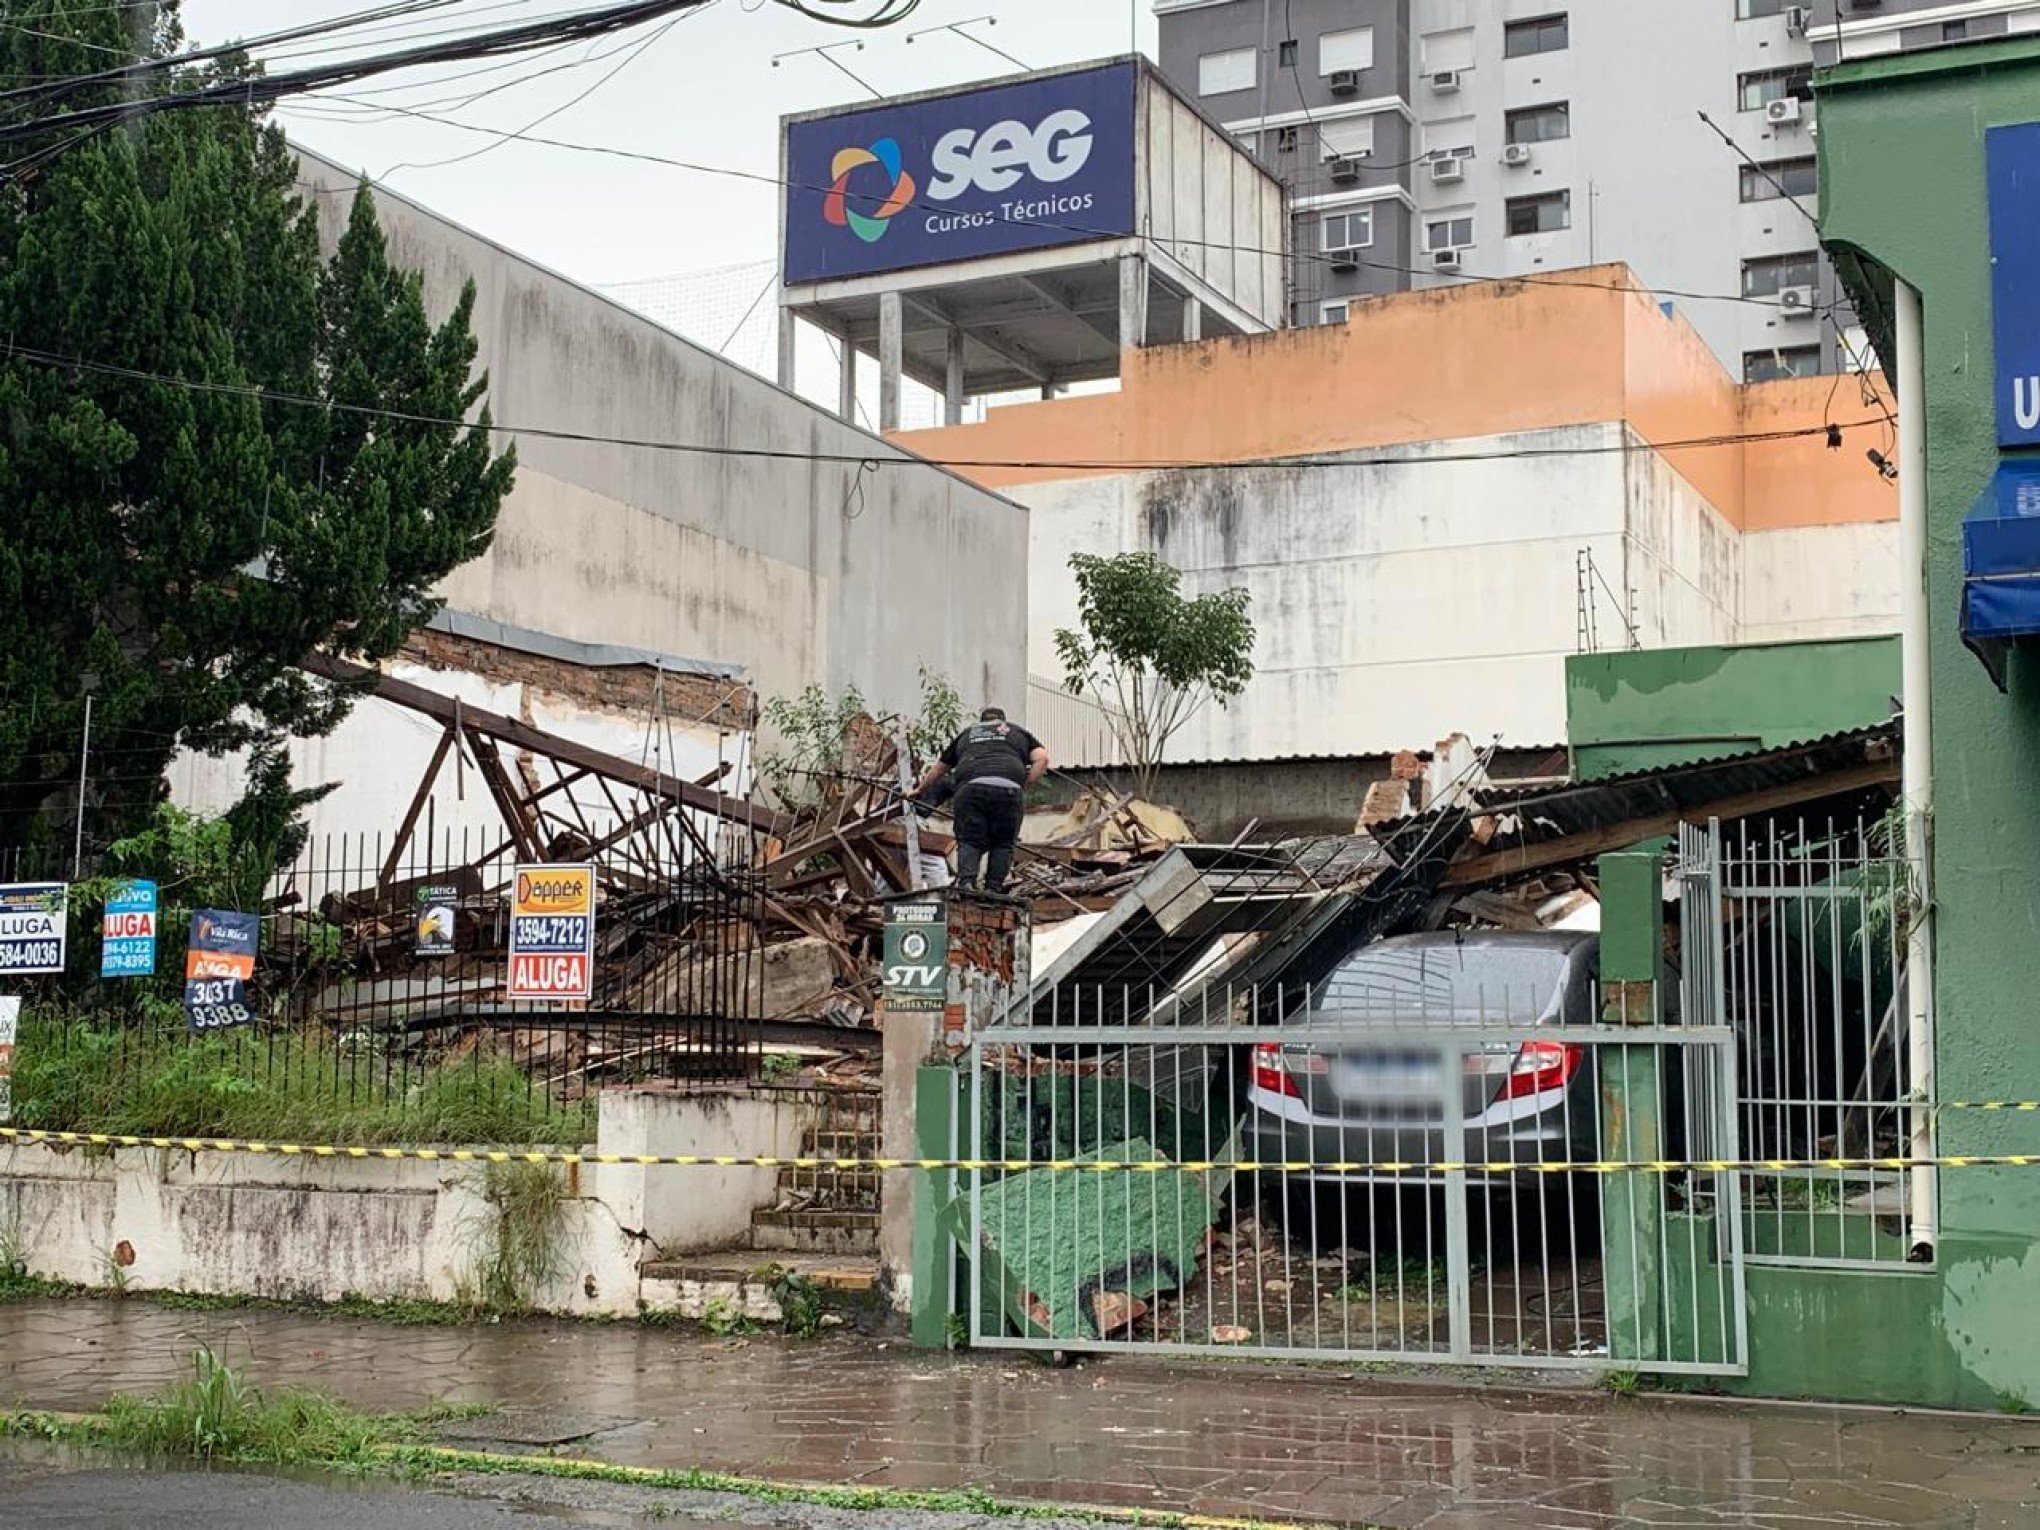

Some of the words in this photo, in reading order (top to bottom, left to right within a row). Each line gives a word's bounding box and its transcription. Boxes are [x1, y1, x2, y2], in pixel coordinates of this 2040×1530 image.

[925, 211, 994, 233] Cursos
[1001, 193, 1093, 221] Técnicos
[517, 917, 584, 945] 3594-7212
[515, 957, 582, 991] ALUGA
[883, 966, 943, 986] STV
[192, 1003, 249, 1027] 9388
